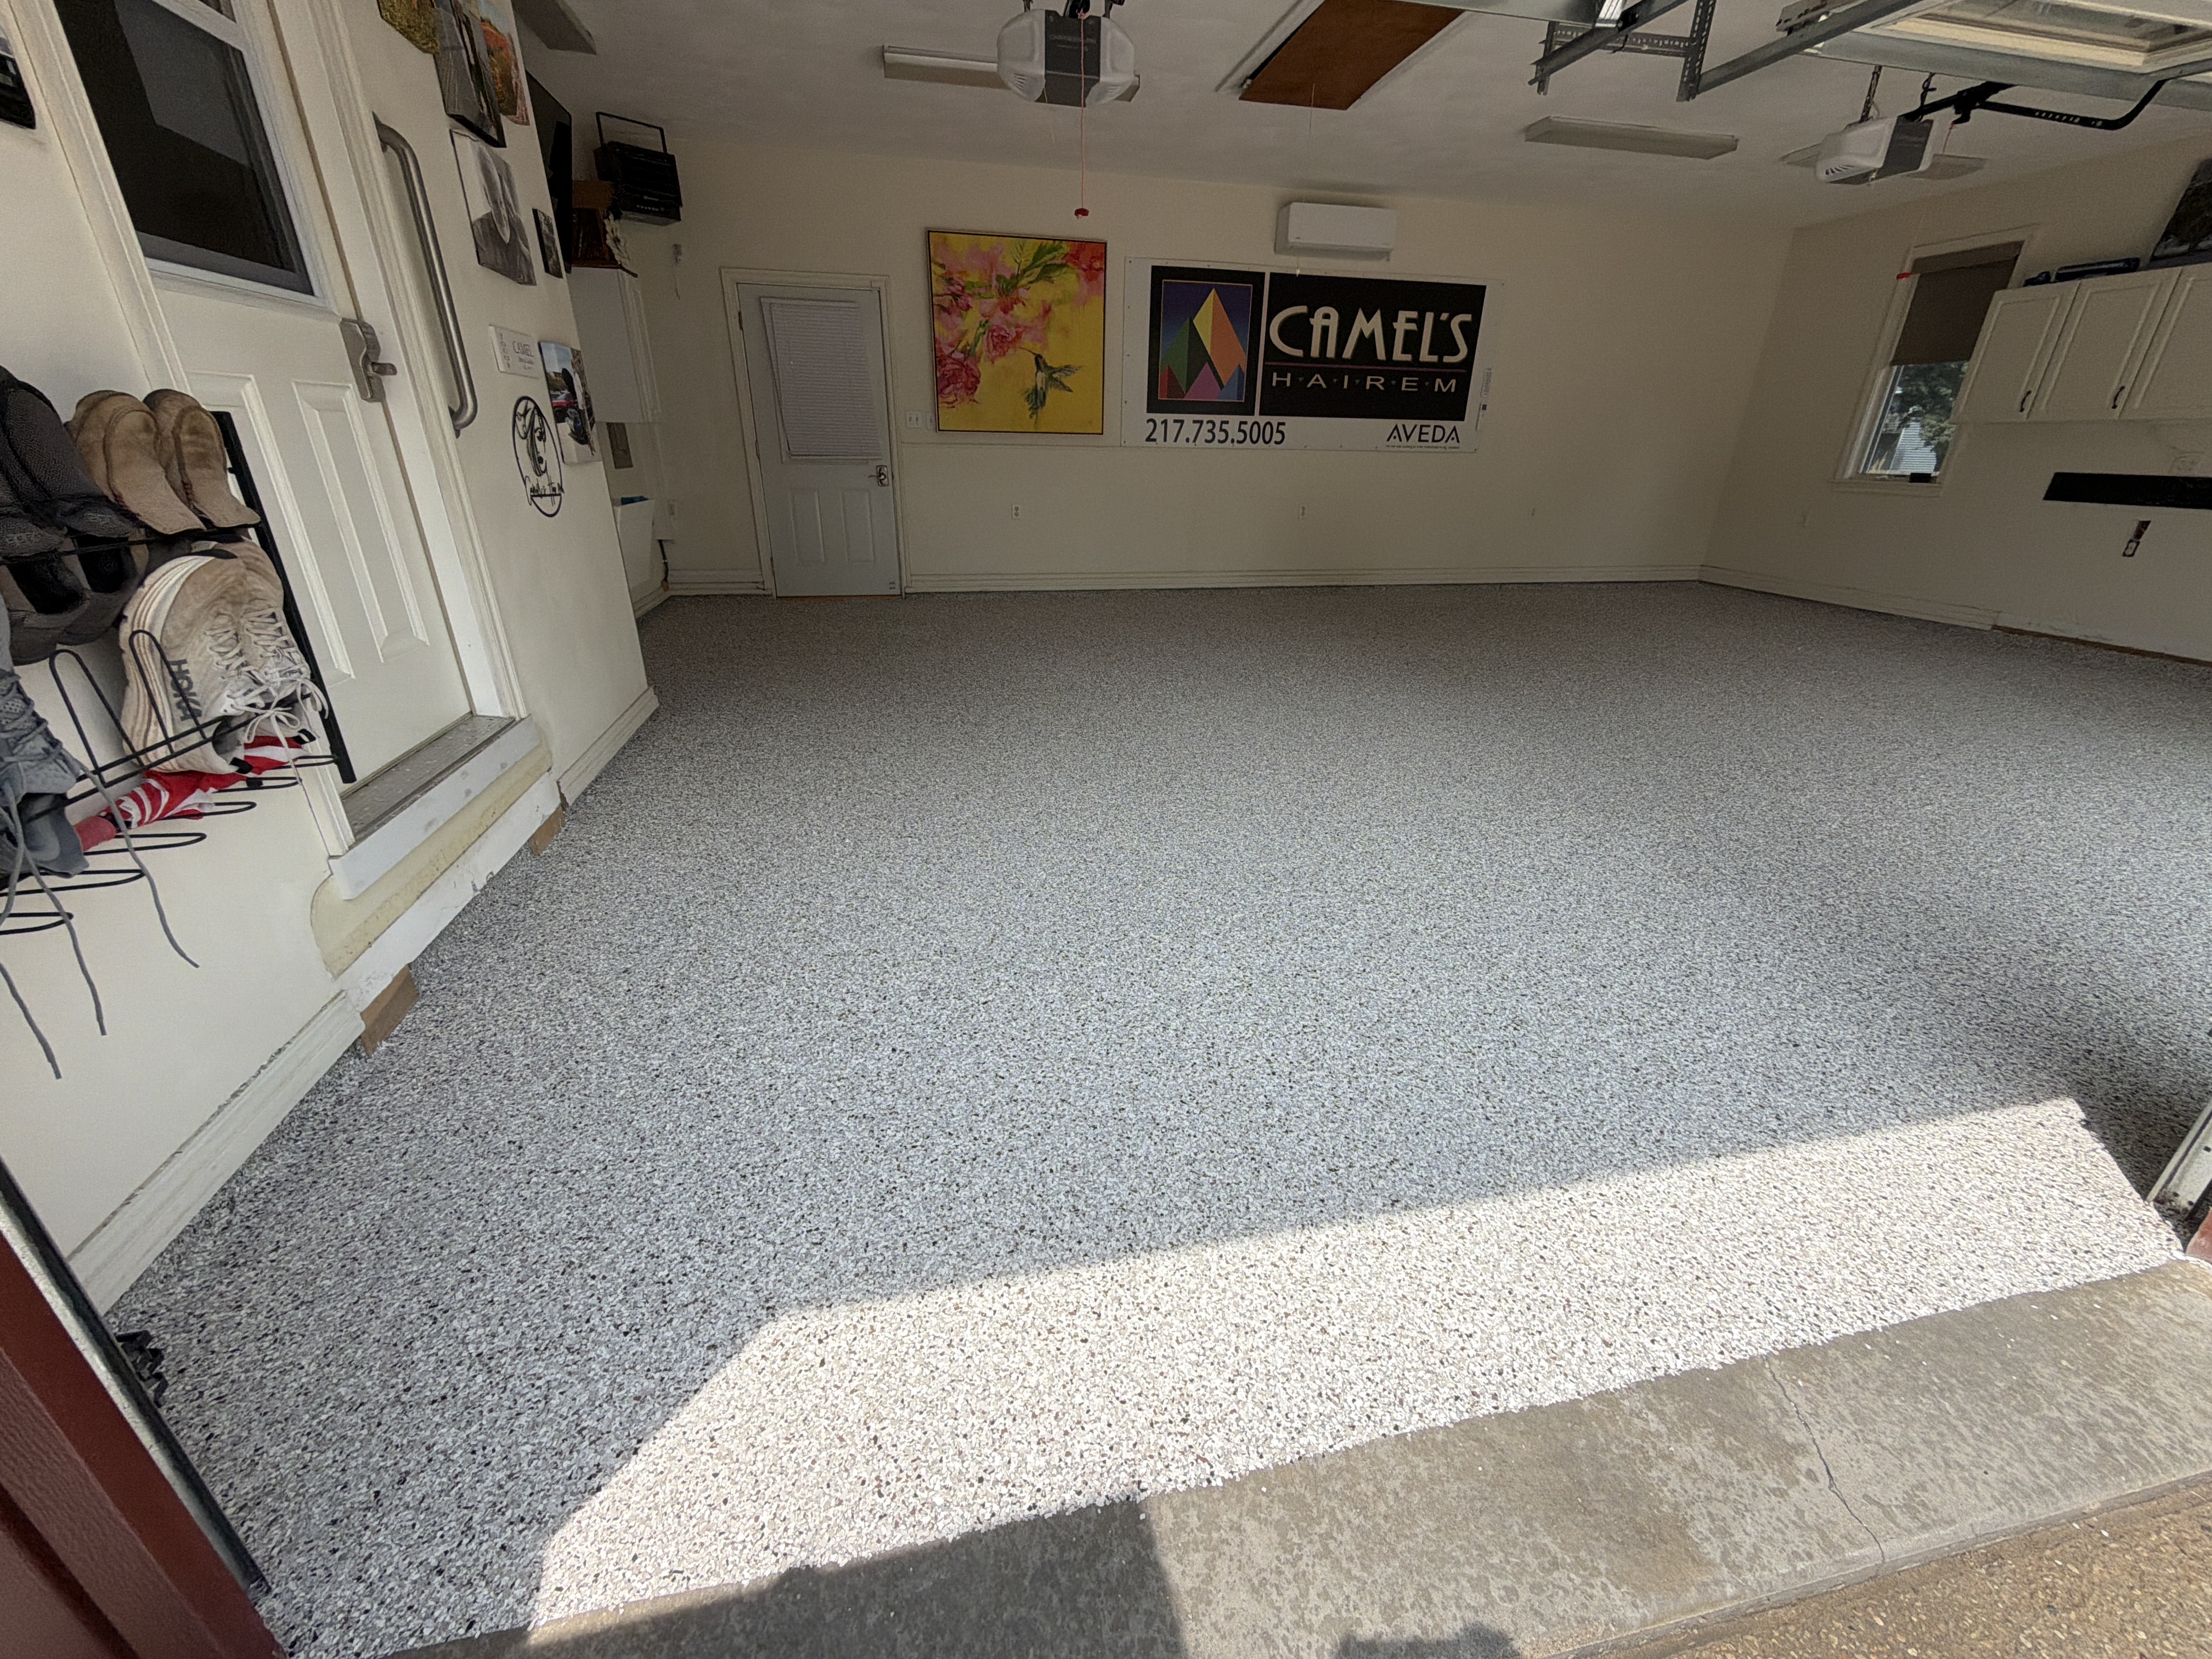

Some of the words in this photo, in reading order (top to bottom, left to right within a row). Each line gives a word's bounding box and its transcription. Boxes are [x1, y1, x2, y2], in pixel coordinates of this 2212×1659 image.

[1269, 305, 1472, 363] CAMEL'S
[1145, 418, 1286, 445] 217.735.5005
[1386, 424, 1460, 443] AVEDA
[168, 659, 202, 721] HOKA
